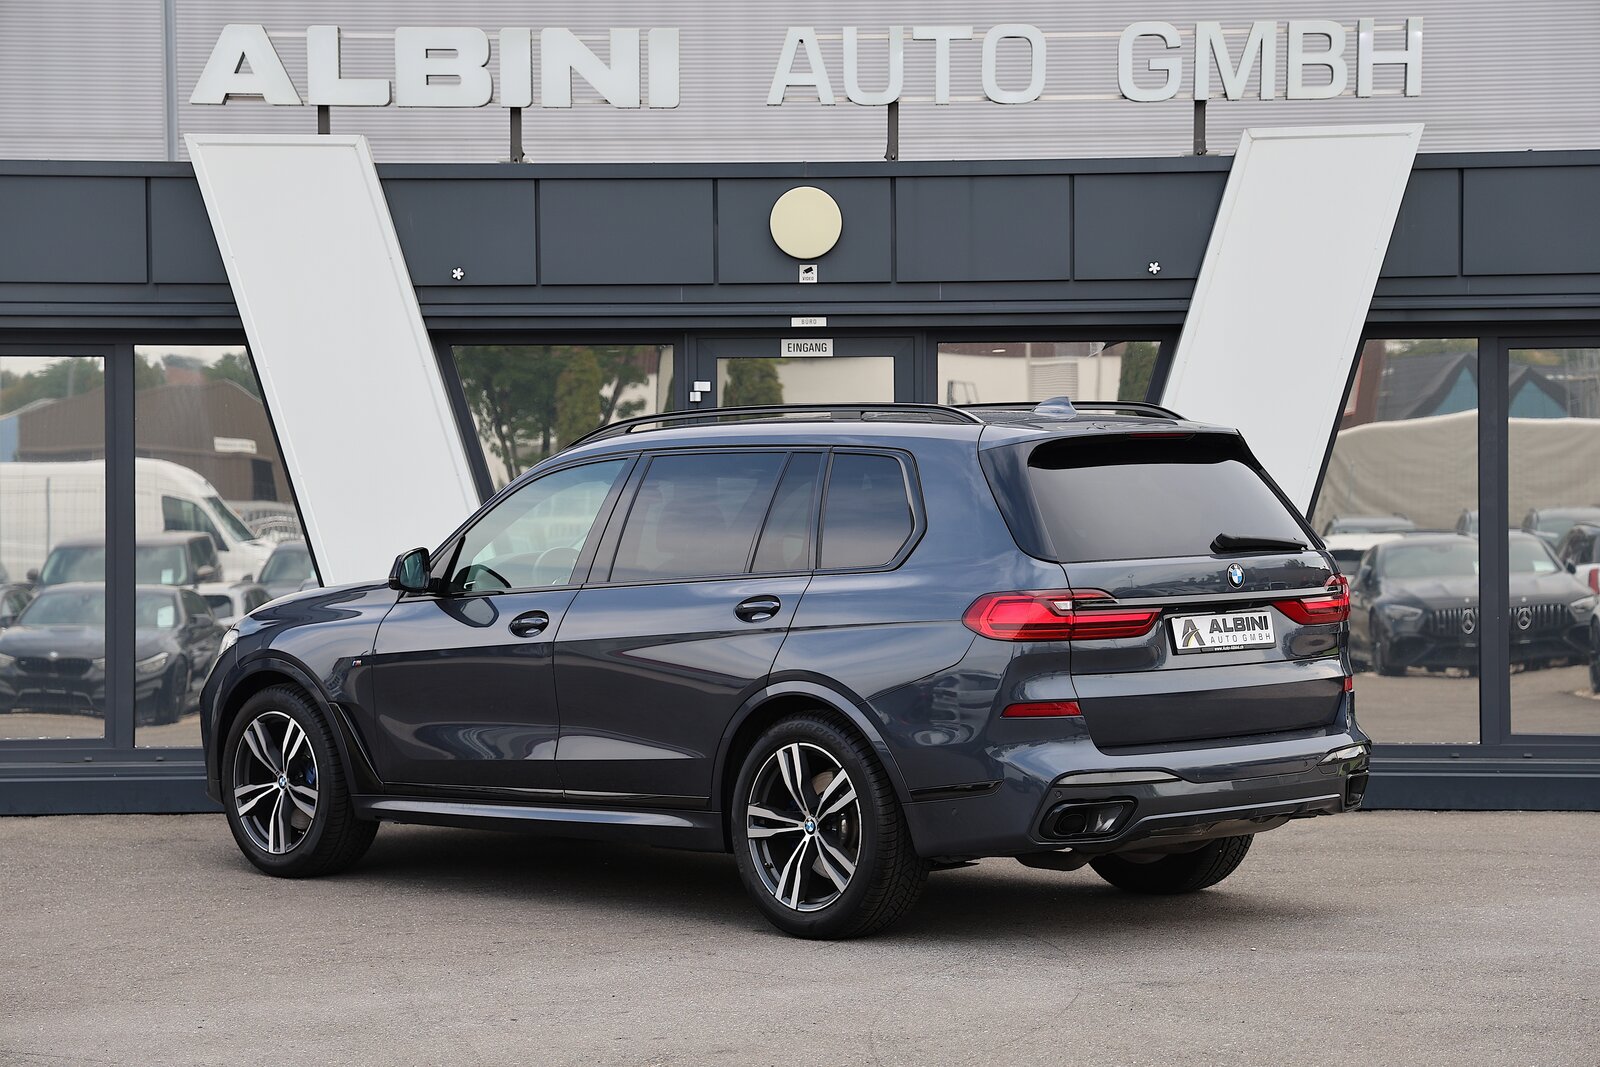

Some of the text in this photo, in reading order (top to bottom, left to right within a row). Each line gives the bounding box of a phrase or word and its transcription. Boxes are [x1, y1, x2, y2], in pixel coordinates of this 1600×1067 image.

[189, 17, 1423, 109] ALBINI AUTO GMBH
[787, 342, 828, 353] EINGANG
[1209, 615, 1269, 634] ALBINI
[1210, 633, 1271, 644] AUTO GMBH
